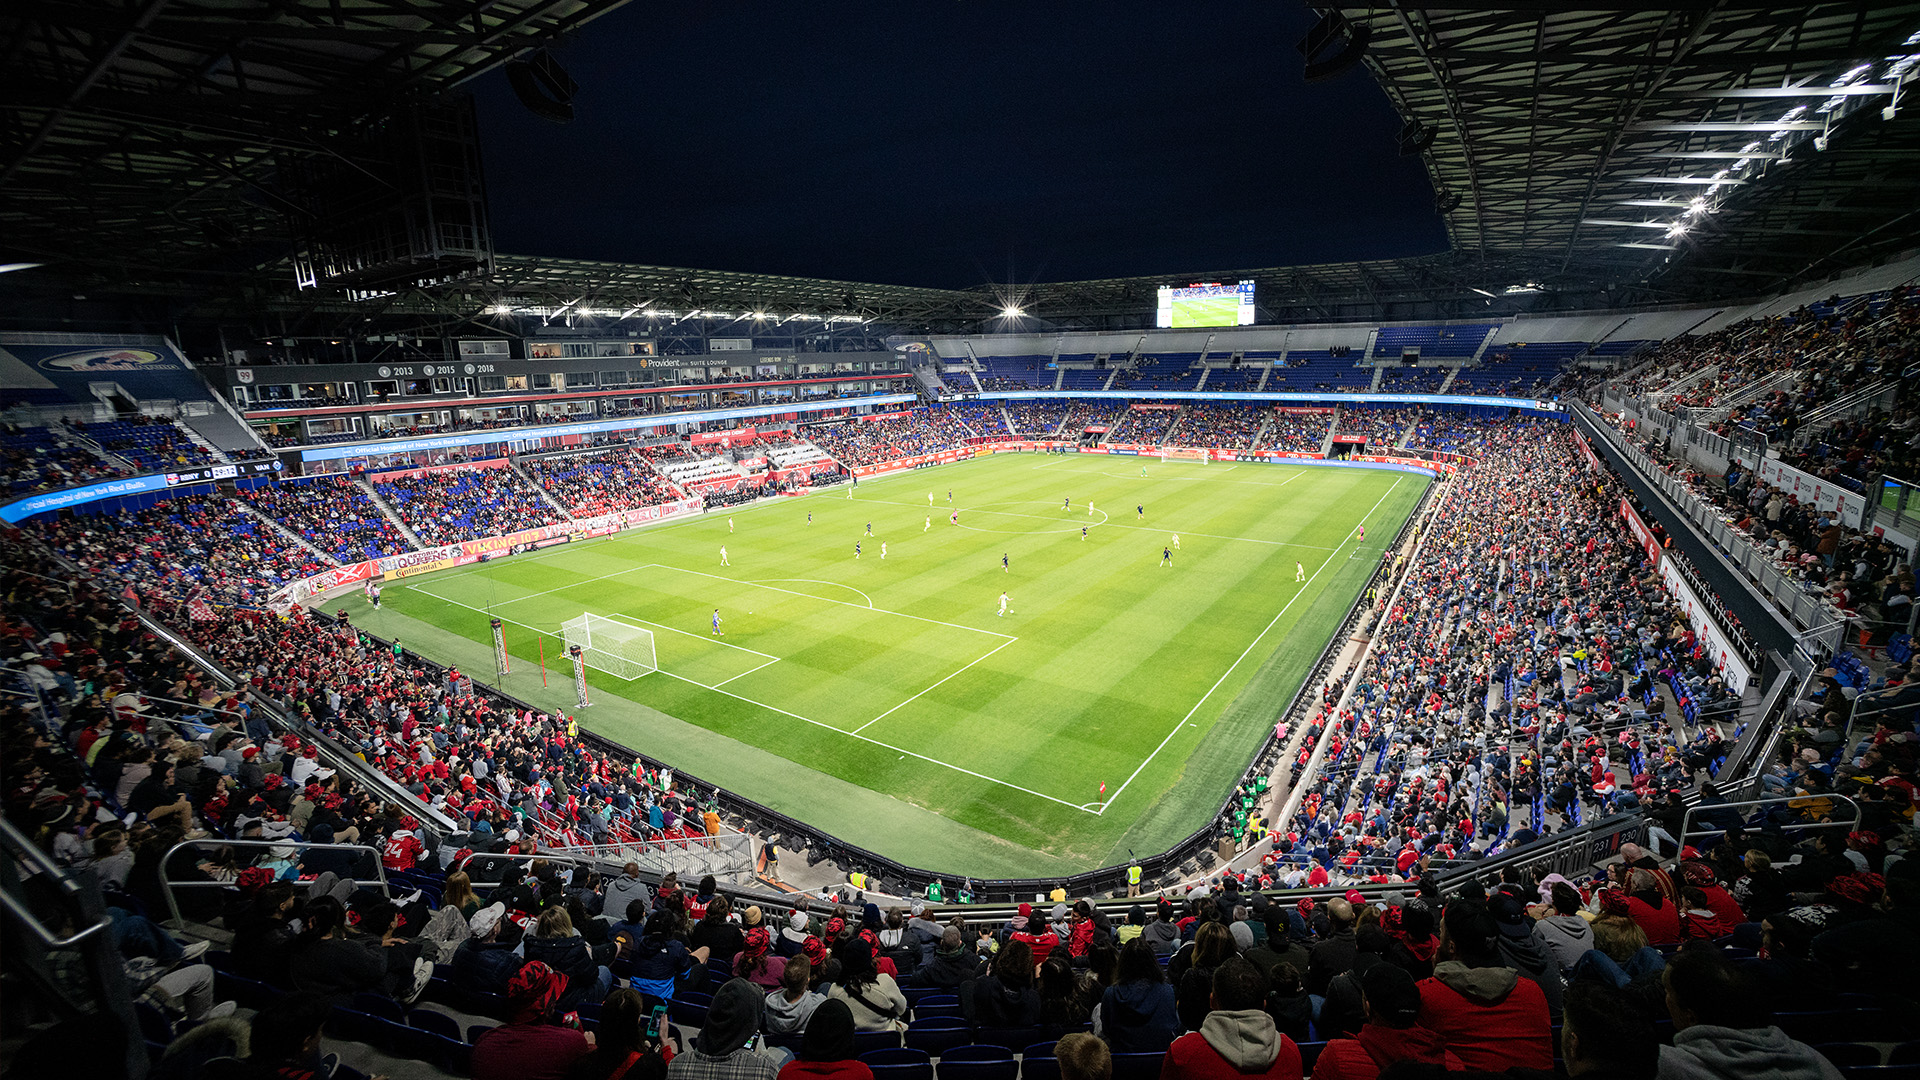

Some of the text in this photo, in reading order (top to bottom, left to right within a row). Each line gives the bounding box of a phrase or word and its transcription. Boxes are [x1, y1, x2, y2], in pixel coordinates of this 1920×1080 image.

[477, 364, 495, 373] 2018
[648, 359, 681, 368] Provident
[240, 371, 250, 380] 99
[393, 367, 414, 376] 2013
[437, 366, 456, 375] 2015
[715, 430, 731, 438] RUNS
[985, 434, 1025, 443] Red Bulls
[355, 446, 379, 454] Official
[380, 443, 407, 452] Hospital
[203, 470, 211, 478] 0
[214, 468, 235, 476] 29:12
[1767, 466, 1776, 475] TOYOTA
[1782, 473, 1792, 483] TOYOTA
[1800, 482, 1811, 493] TOYOTA
[46, 494, 73, 506] Hospital
[80, 490, 95, 499] New
[95, 487, 108, 496] York
[108, 484, 125, 492] Red
[126, 481, 146, 490] Bulls
[1821, 491, 1834, 503] TOYOTA
[687, 499, 702, 509] ARMY
[1844, 502, 1859, 515] TOYOTA
[466, 536, 517, 554] VIKING
[520, 531, 540, 544] 107
[397, 549, 447, 569] QUEENS
[407, 550, 438, 559] ASTORIA
[459, 555, 477, 564] Audi
[395, 563, 437, 578] Continental
[1726, 662, 1738, 685] TOYOTA
[1593, 829, 1637, 854] 231 230
[384, 842, 403, 859] 24
[930, 887, 938, 896] 14
